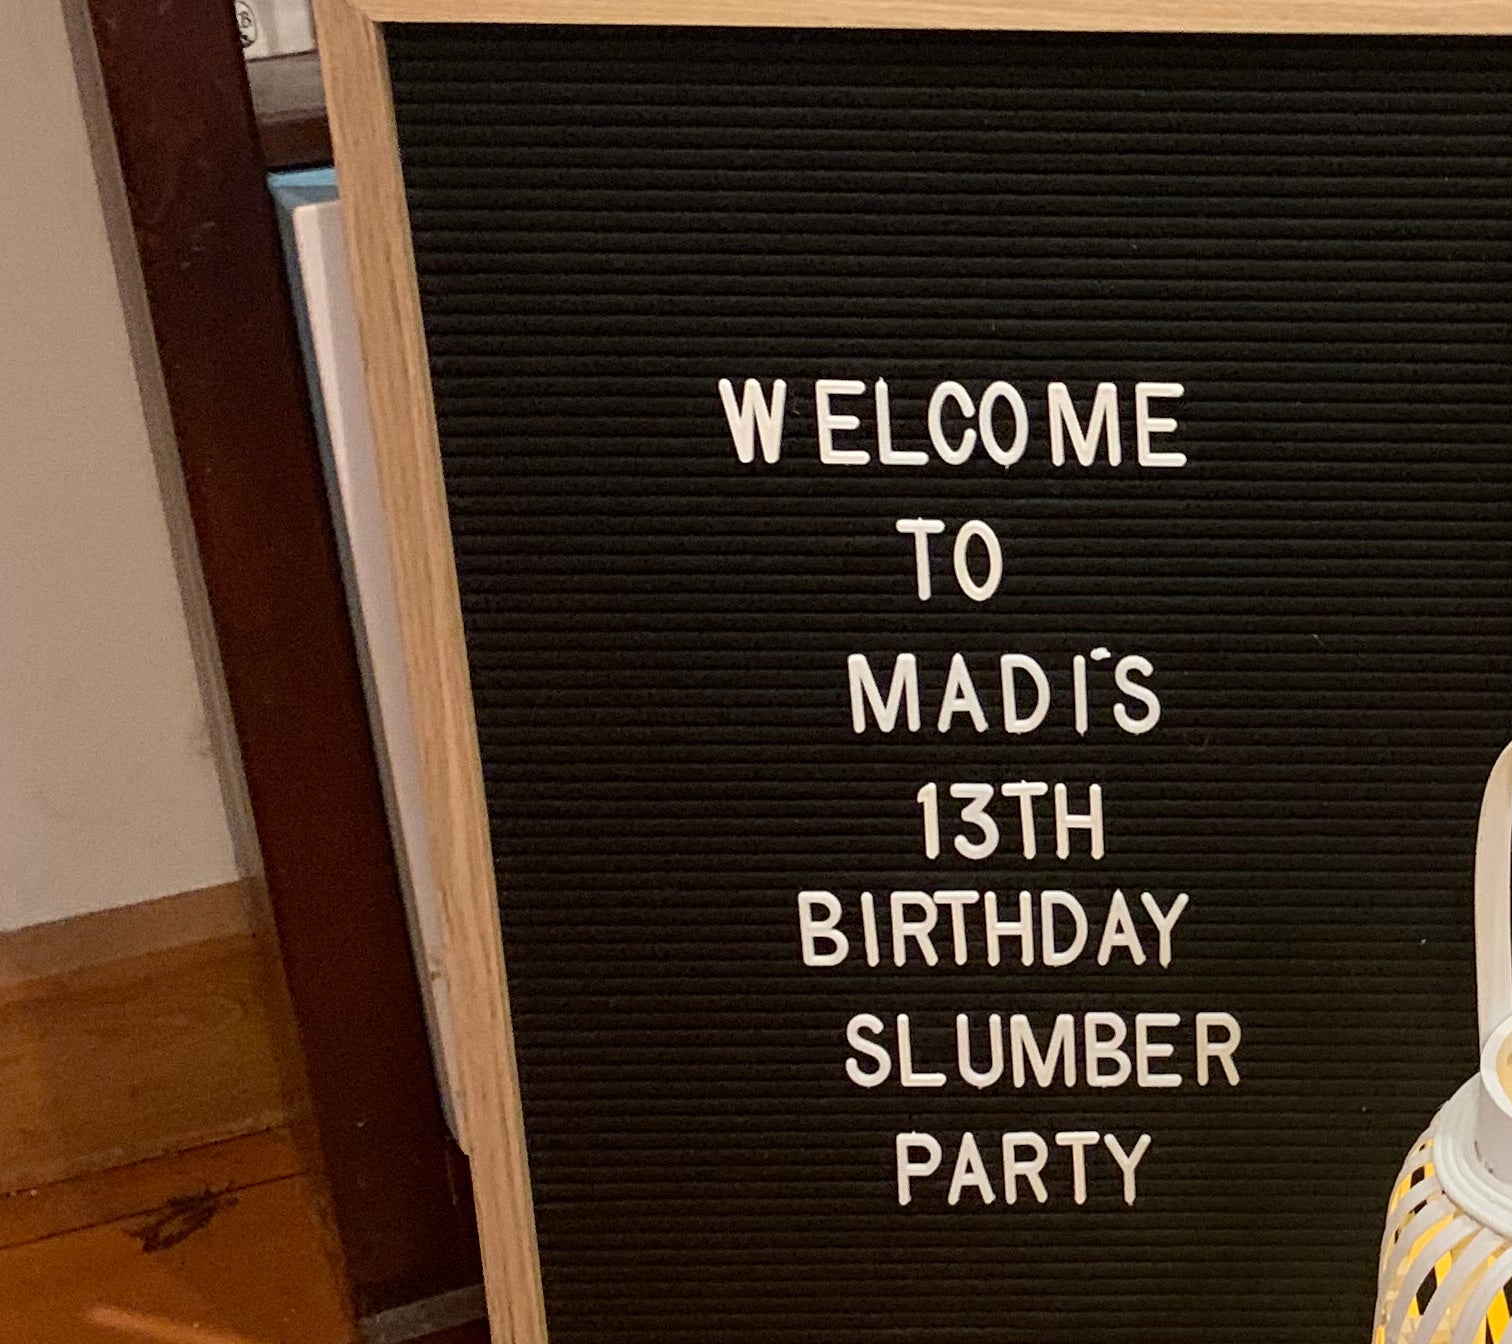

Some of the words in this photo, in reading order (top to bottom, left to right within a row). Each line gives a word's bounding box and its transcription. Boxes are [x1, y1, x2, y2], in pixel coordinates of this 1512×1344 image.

[719, 377, 1188, 468] WELCOME
[896, 517, 1004, 602] TO
[848, 647, 1162, 736] MADI'S
[917, 780, 1105, 860] 13TH
[798, 888, 1190, 969] BIRTHDAY
[845, 1011, 1242, 1090] SLUMBER
[896, 1130, 1152, 1207] PARTY
